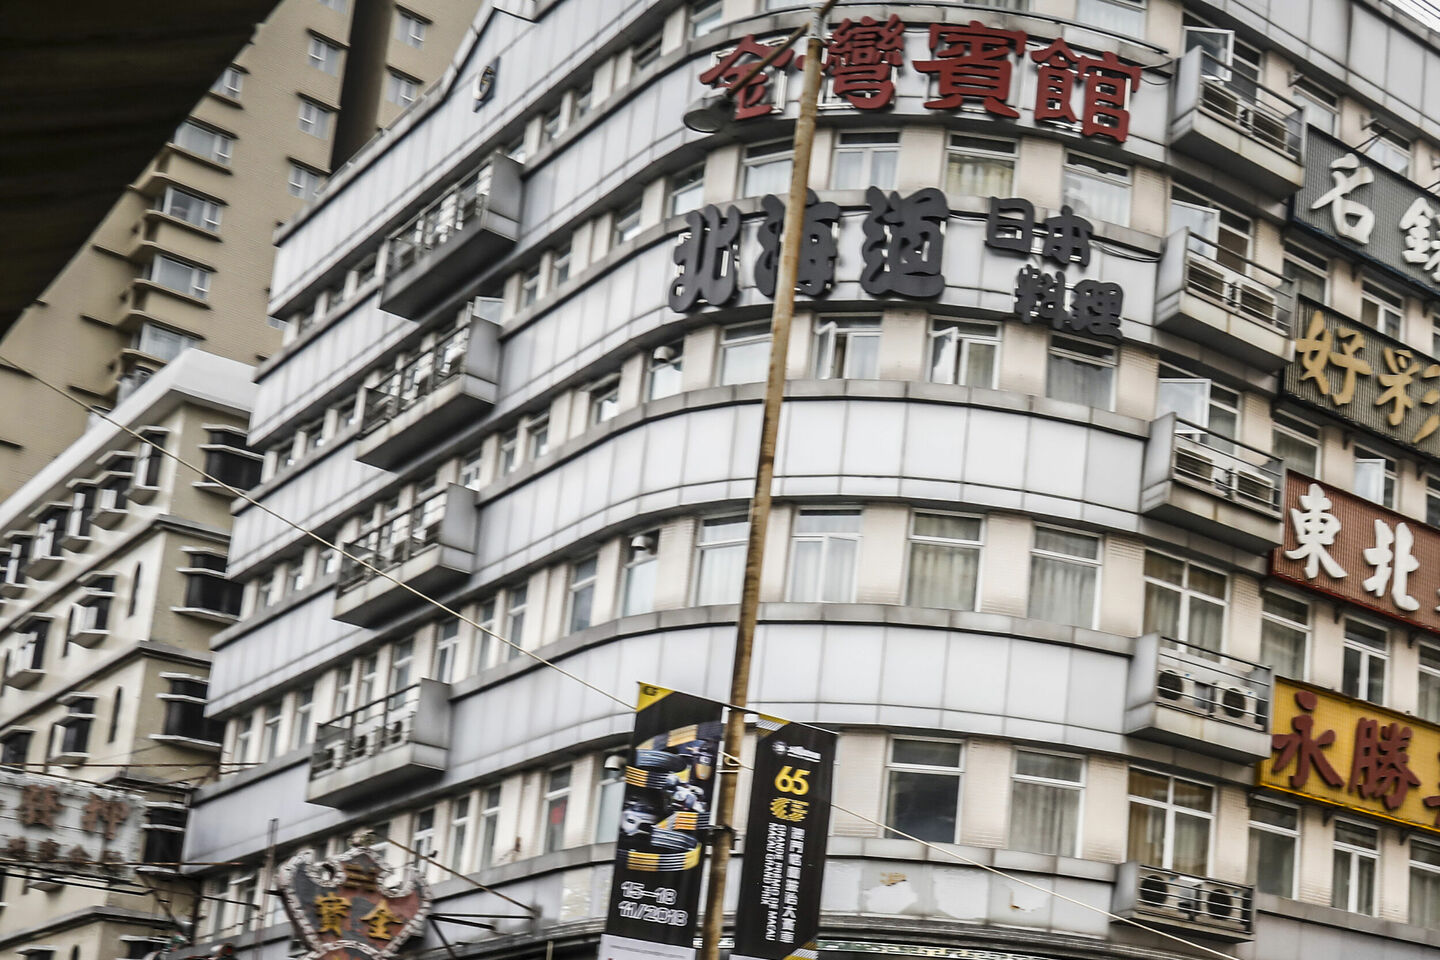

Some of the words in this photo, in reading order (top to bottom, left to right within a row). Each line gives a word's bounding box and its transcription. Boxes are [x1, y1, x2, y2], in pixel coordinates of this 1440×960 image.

[668, 185, 949, 314] 北海道
[985, 196, 1094, 268] 日本
[1014, 263, 1124, 342] 料理
[774, 765, 811, 796] 65
